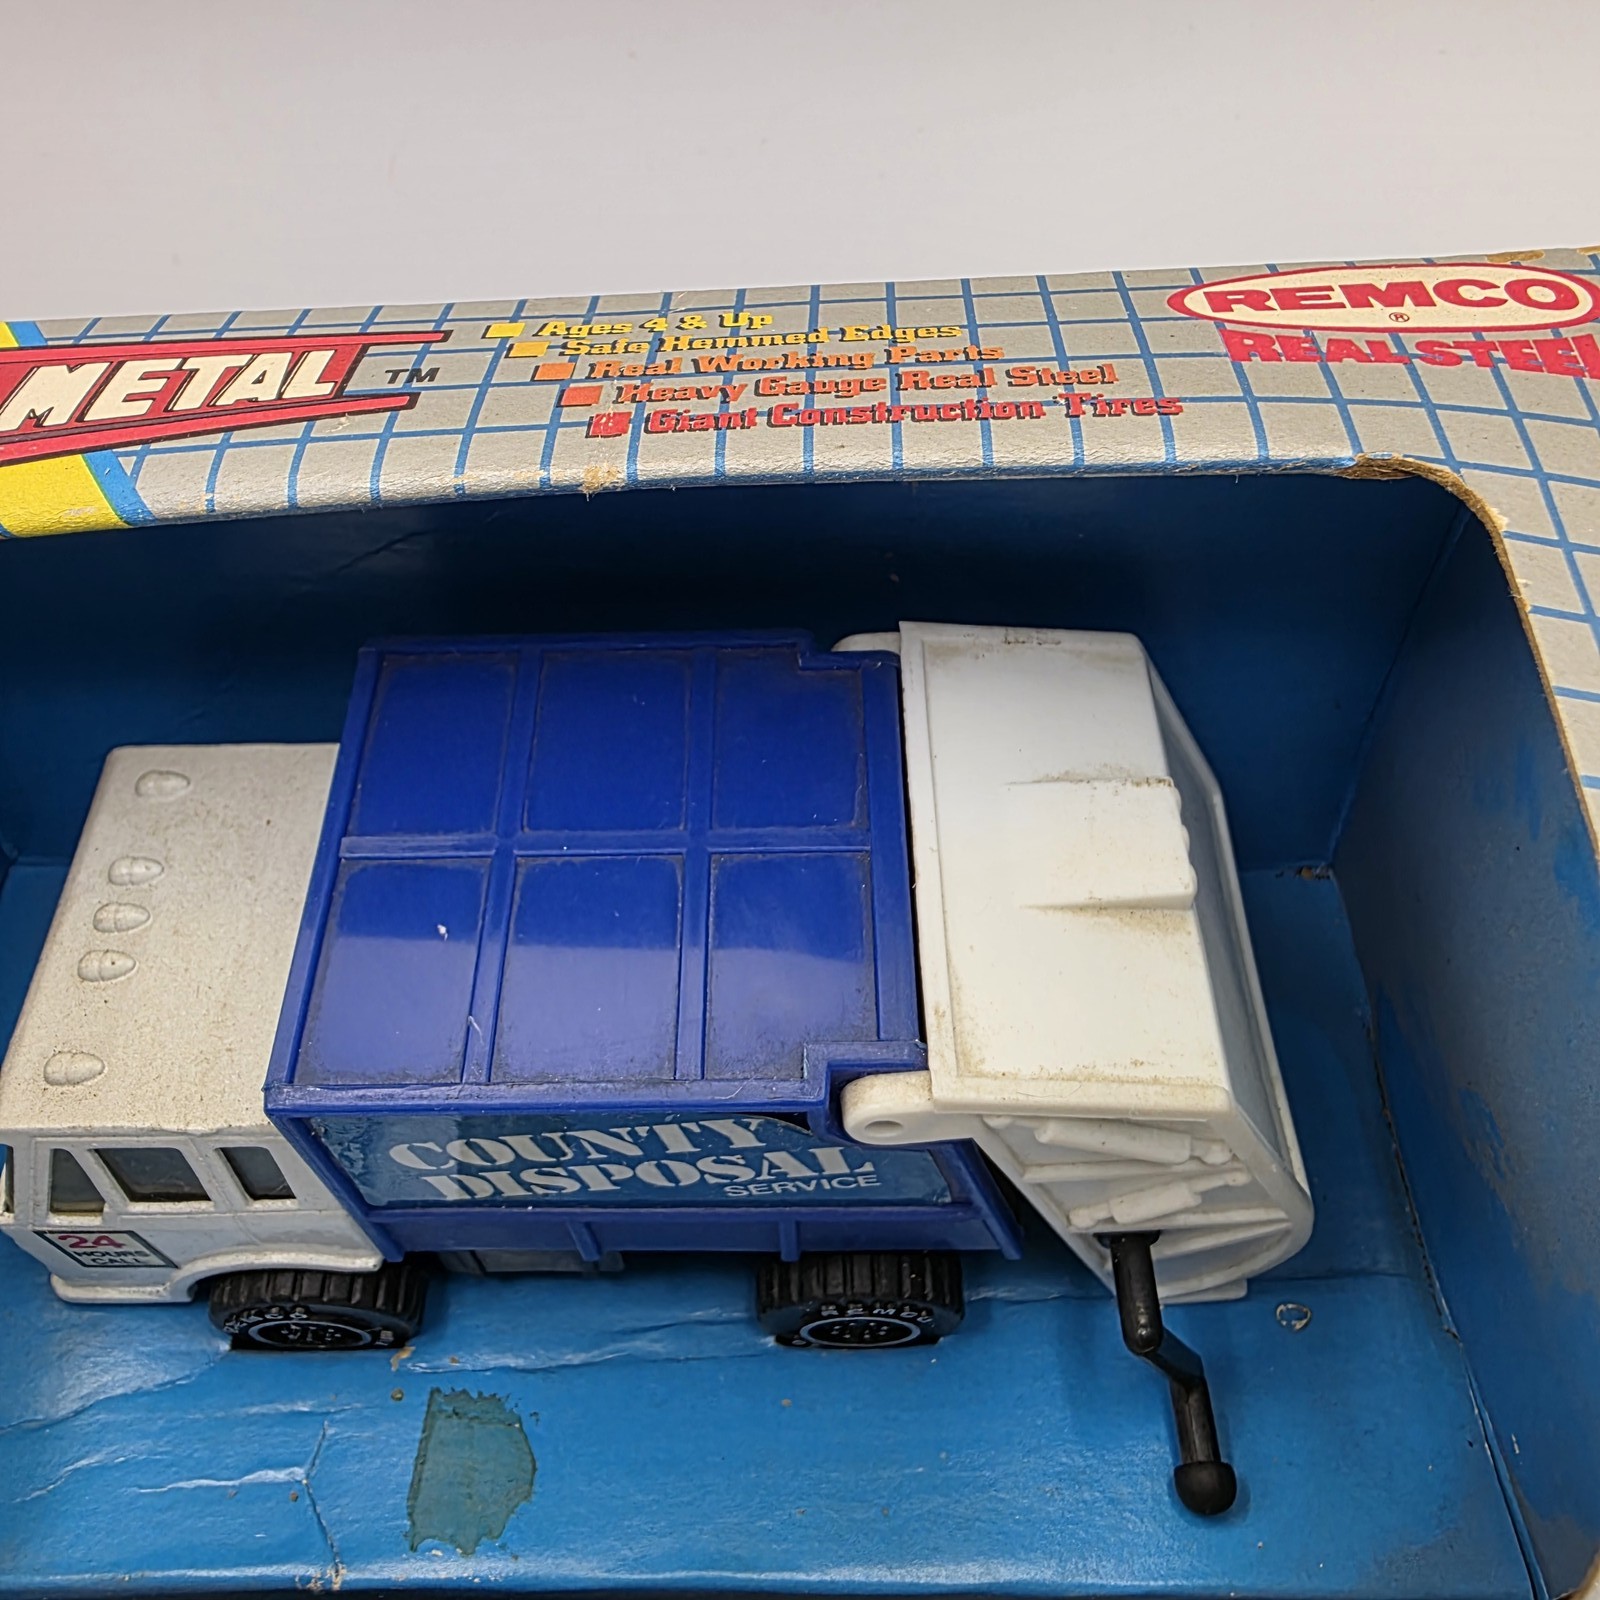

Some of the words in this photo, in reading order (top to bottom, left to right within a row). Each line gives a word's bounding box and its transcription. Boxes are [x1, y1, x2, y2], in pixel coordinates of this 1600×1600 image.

[1203, 278, 1580, 313] REMCO
[536, 321, 633, 339] Ages
[640, 317, 668, 333] 4
[676, 314, 709, 330] &
[720, 312, 774, 330] Up
[559, 339, 649, 356] Safe
[656, 327, 831, 352] Hemmed
[839, 324, 963, 344] Edges
[586, 357, 683, 379] Real
[691, 350, 876, 375] Working
[885, 345, 1006, 365] Parts
[1218, 328, 1410, 364] REAL
[0, 350, 337, 432] METAL
[385, 366, 440, 384] TM
[613, 381, 748, 405] Heavy
[754, 374, 887, 399] Gauge
[896, 367, 998, 391] Real
[1005, 363, 1120, 387] Steel
[644, 406, 758, 434] Giant
[766, 396, 1047, 428] Construction
[1056, 392, 1185, 418] Tires
[389, 1118, 767, 1170] COUNTY
[422, 1146, 876, 1200] DISPOSAL
[723, 1174, 882, 1197] SERVICE
[57, 1234, 127, 1249] 24
